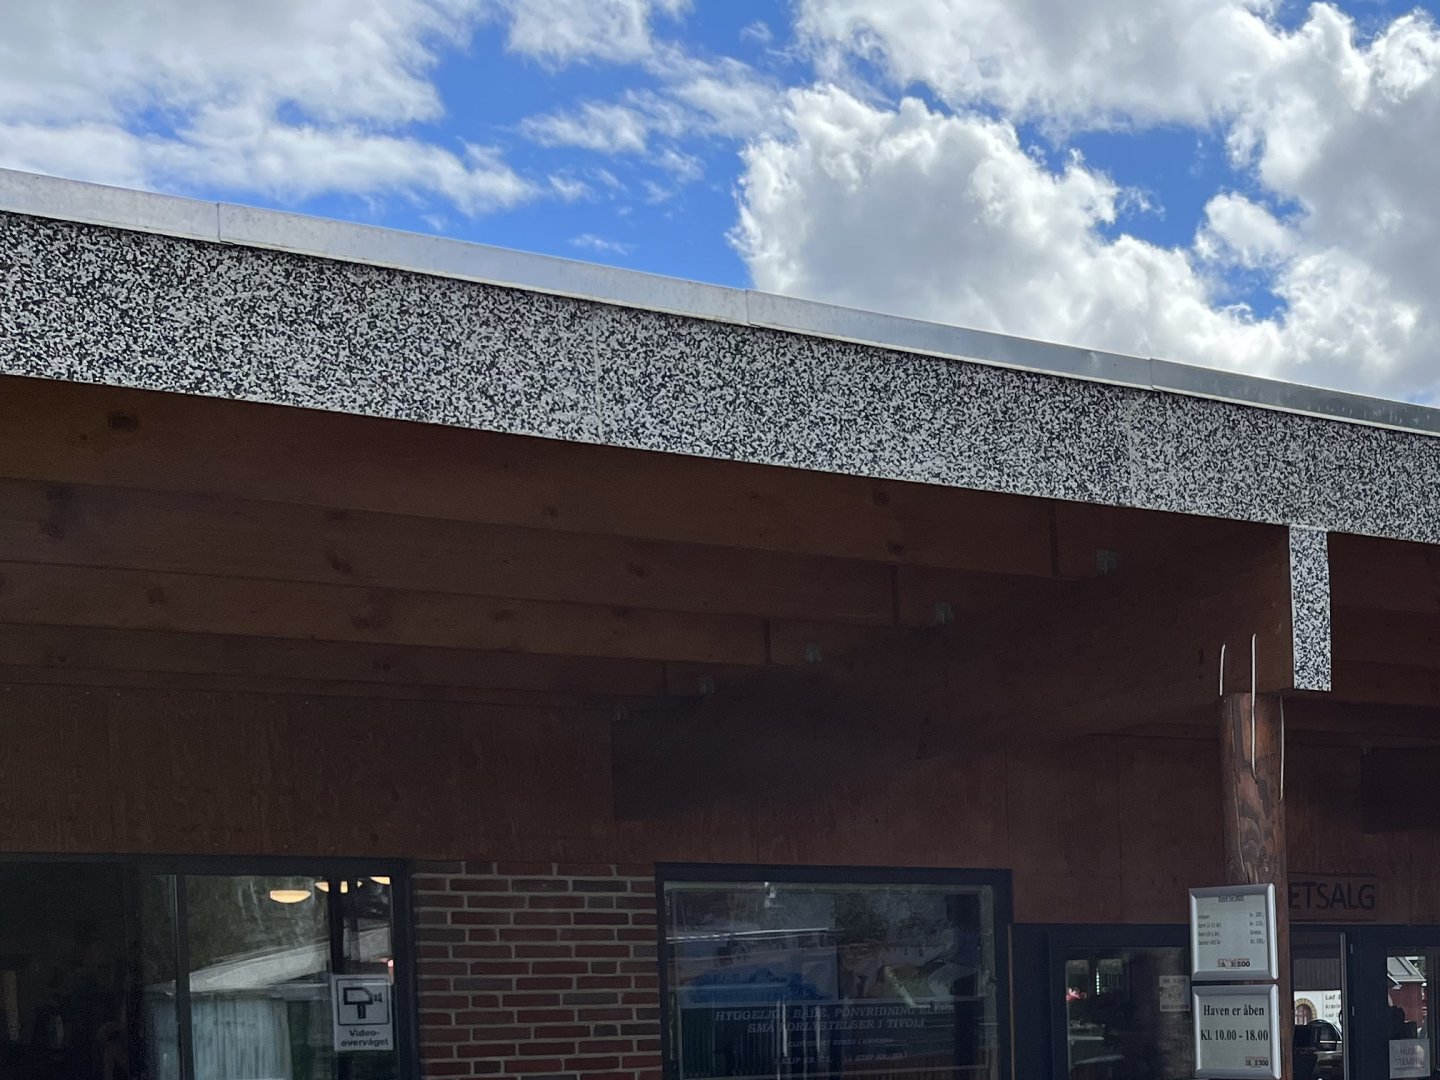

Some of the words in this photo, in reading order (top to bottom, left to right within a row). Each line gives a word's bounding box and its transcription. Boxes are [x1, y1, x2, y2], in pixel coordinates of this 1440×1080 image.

[1203, 1004, 1230, 1016] Haven
[1231, 1007, 1241, 1016] er
[1243, 1003, 1265, 1016] åben
[349, 1029, 381, 1037] Video-
[1215, 1029, 1237, 1041] 10.00
[1245, 1029, 1269, 1041] 18.00
[341, 1038, 389, 1048] overvåget
